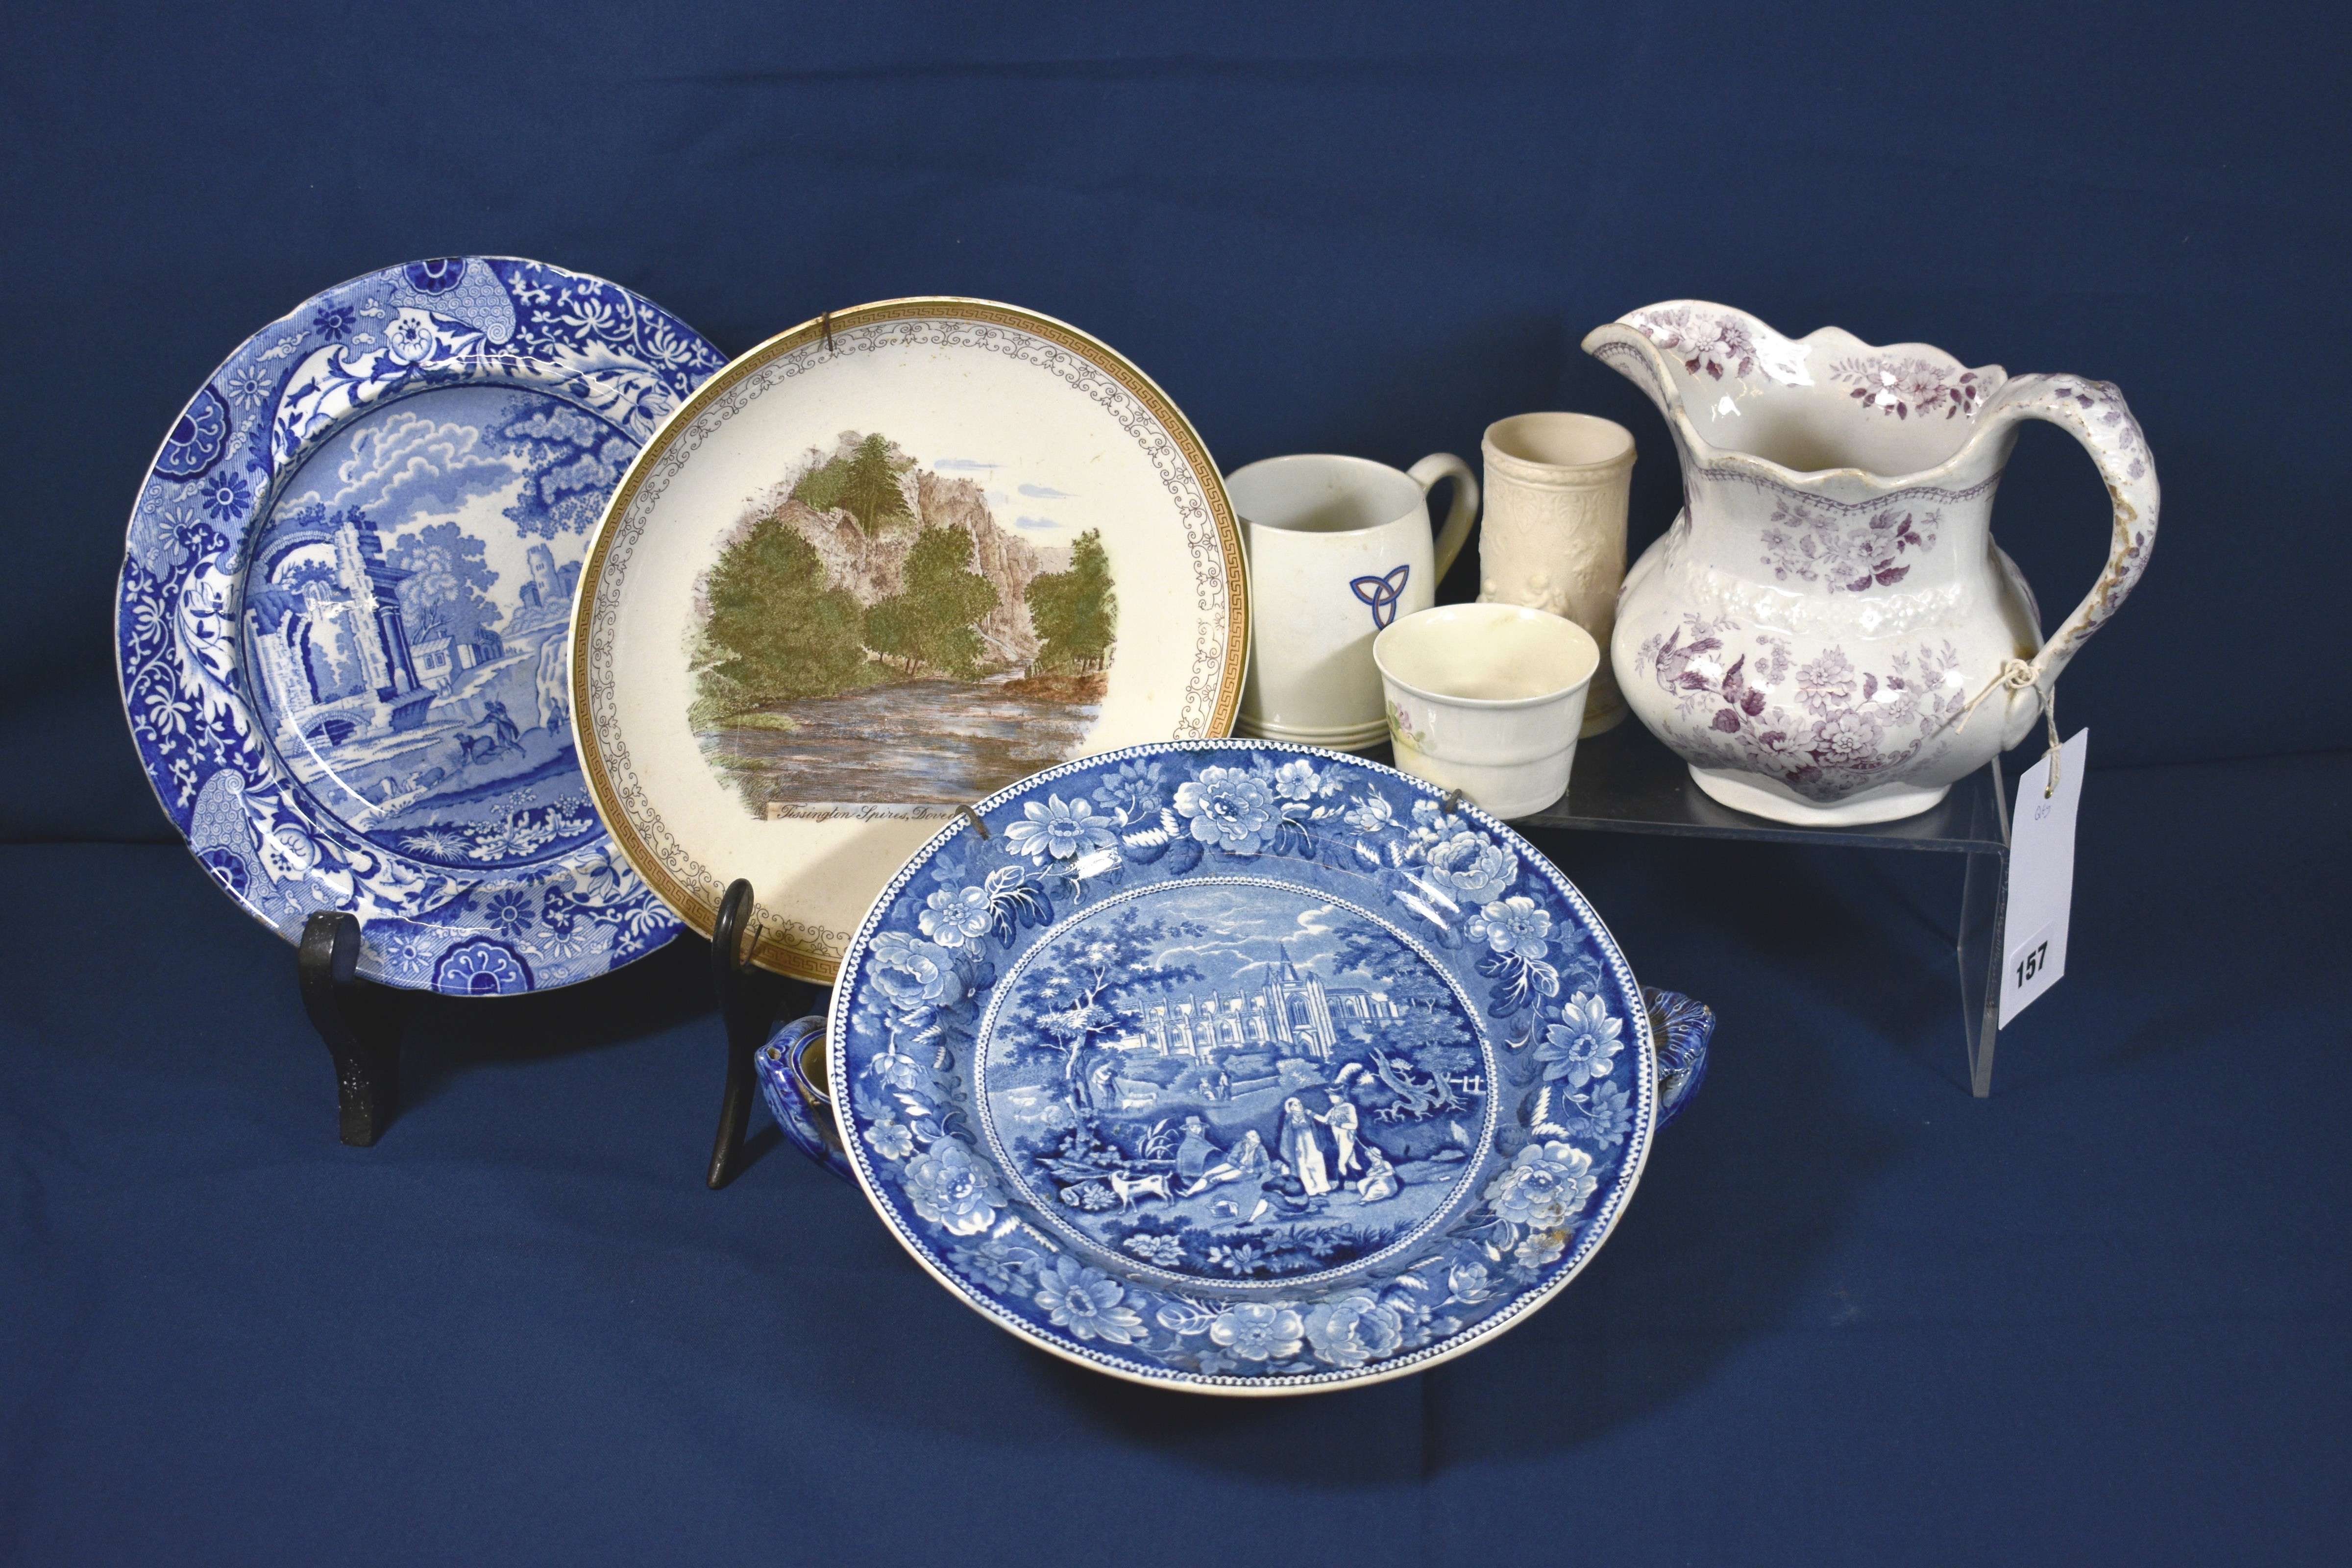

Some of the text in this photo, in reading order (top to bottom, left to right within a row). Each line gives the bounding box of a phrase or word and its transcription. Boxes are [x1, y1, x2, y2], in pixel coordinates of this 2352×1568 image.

[777, 803, 852, 823] Tissington
[856, 805, 908, 823] Spires,
[2016, 940, 2048, 989] 157
